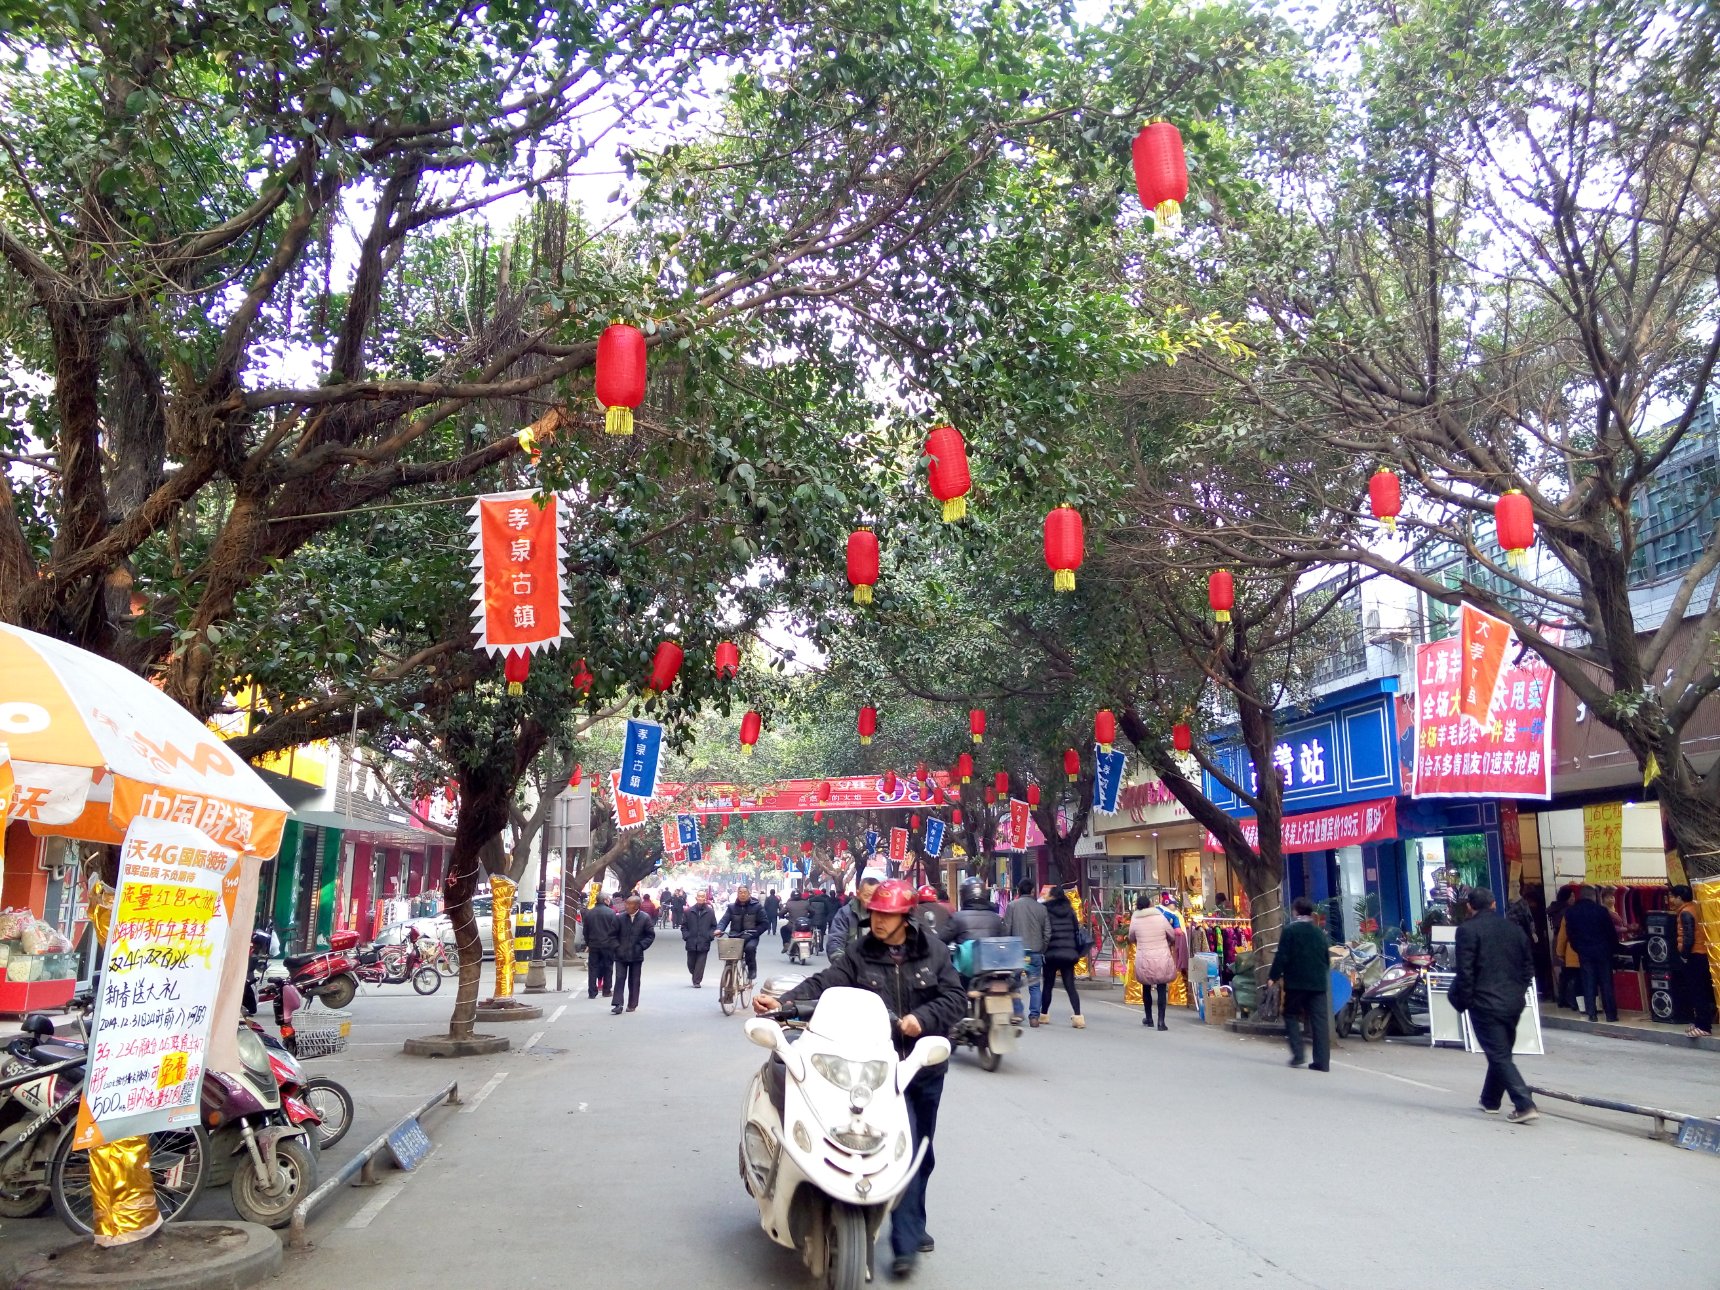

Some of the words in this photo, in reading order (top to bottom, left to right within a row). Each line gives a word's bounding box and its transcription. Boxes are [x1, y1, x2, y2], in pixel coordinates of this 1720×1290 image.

[508, 508, 536, 628] 孝泉古鎮
[1420, 717, 1544, 749] 全场羊毛衫买件送一件
[105, 977, 181, 1009] 新春送大礼
